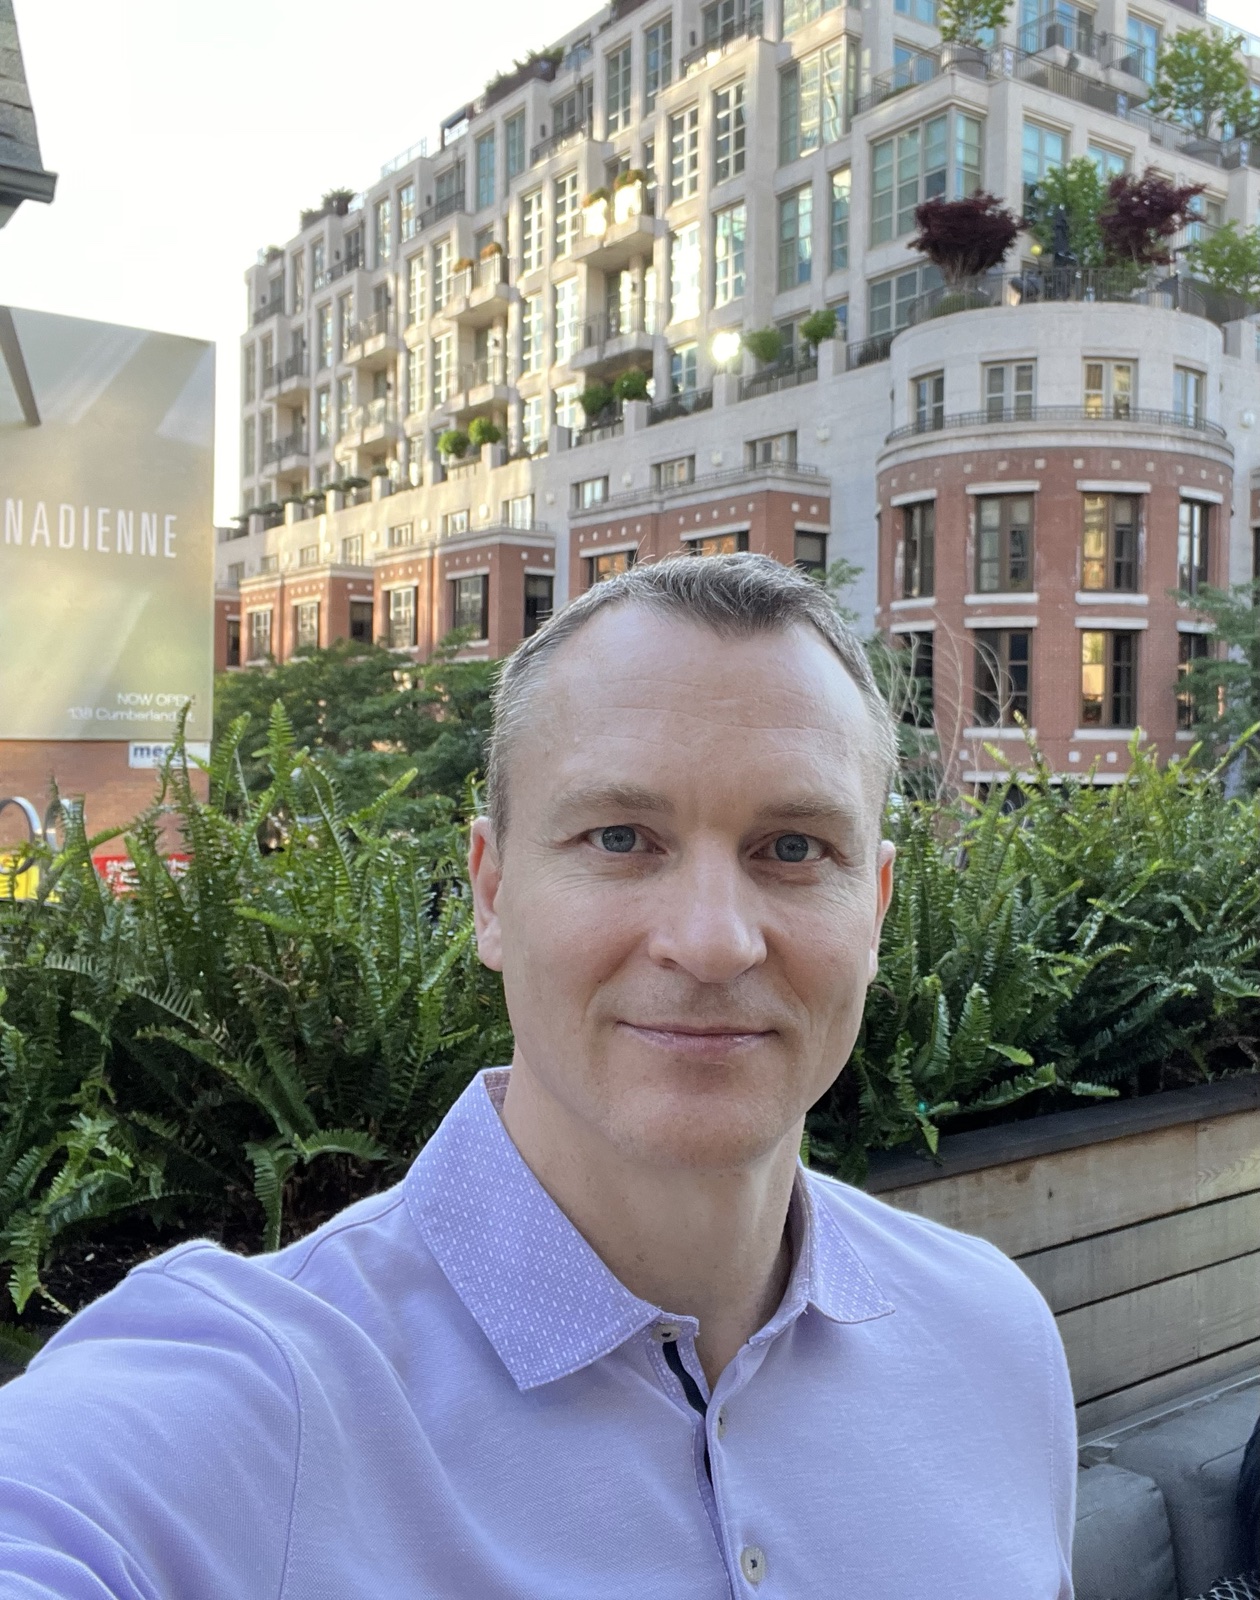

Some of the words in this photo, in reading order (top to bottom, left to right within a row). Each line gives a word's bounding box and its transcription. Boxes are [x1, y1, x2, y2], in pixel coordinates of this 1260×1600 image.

[4, 497, 178, 559] NADIENNE
[117, 692, 154, 706] NOW
[95, 707, 177, 722] Cumberland
